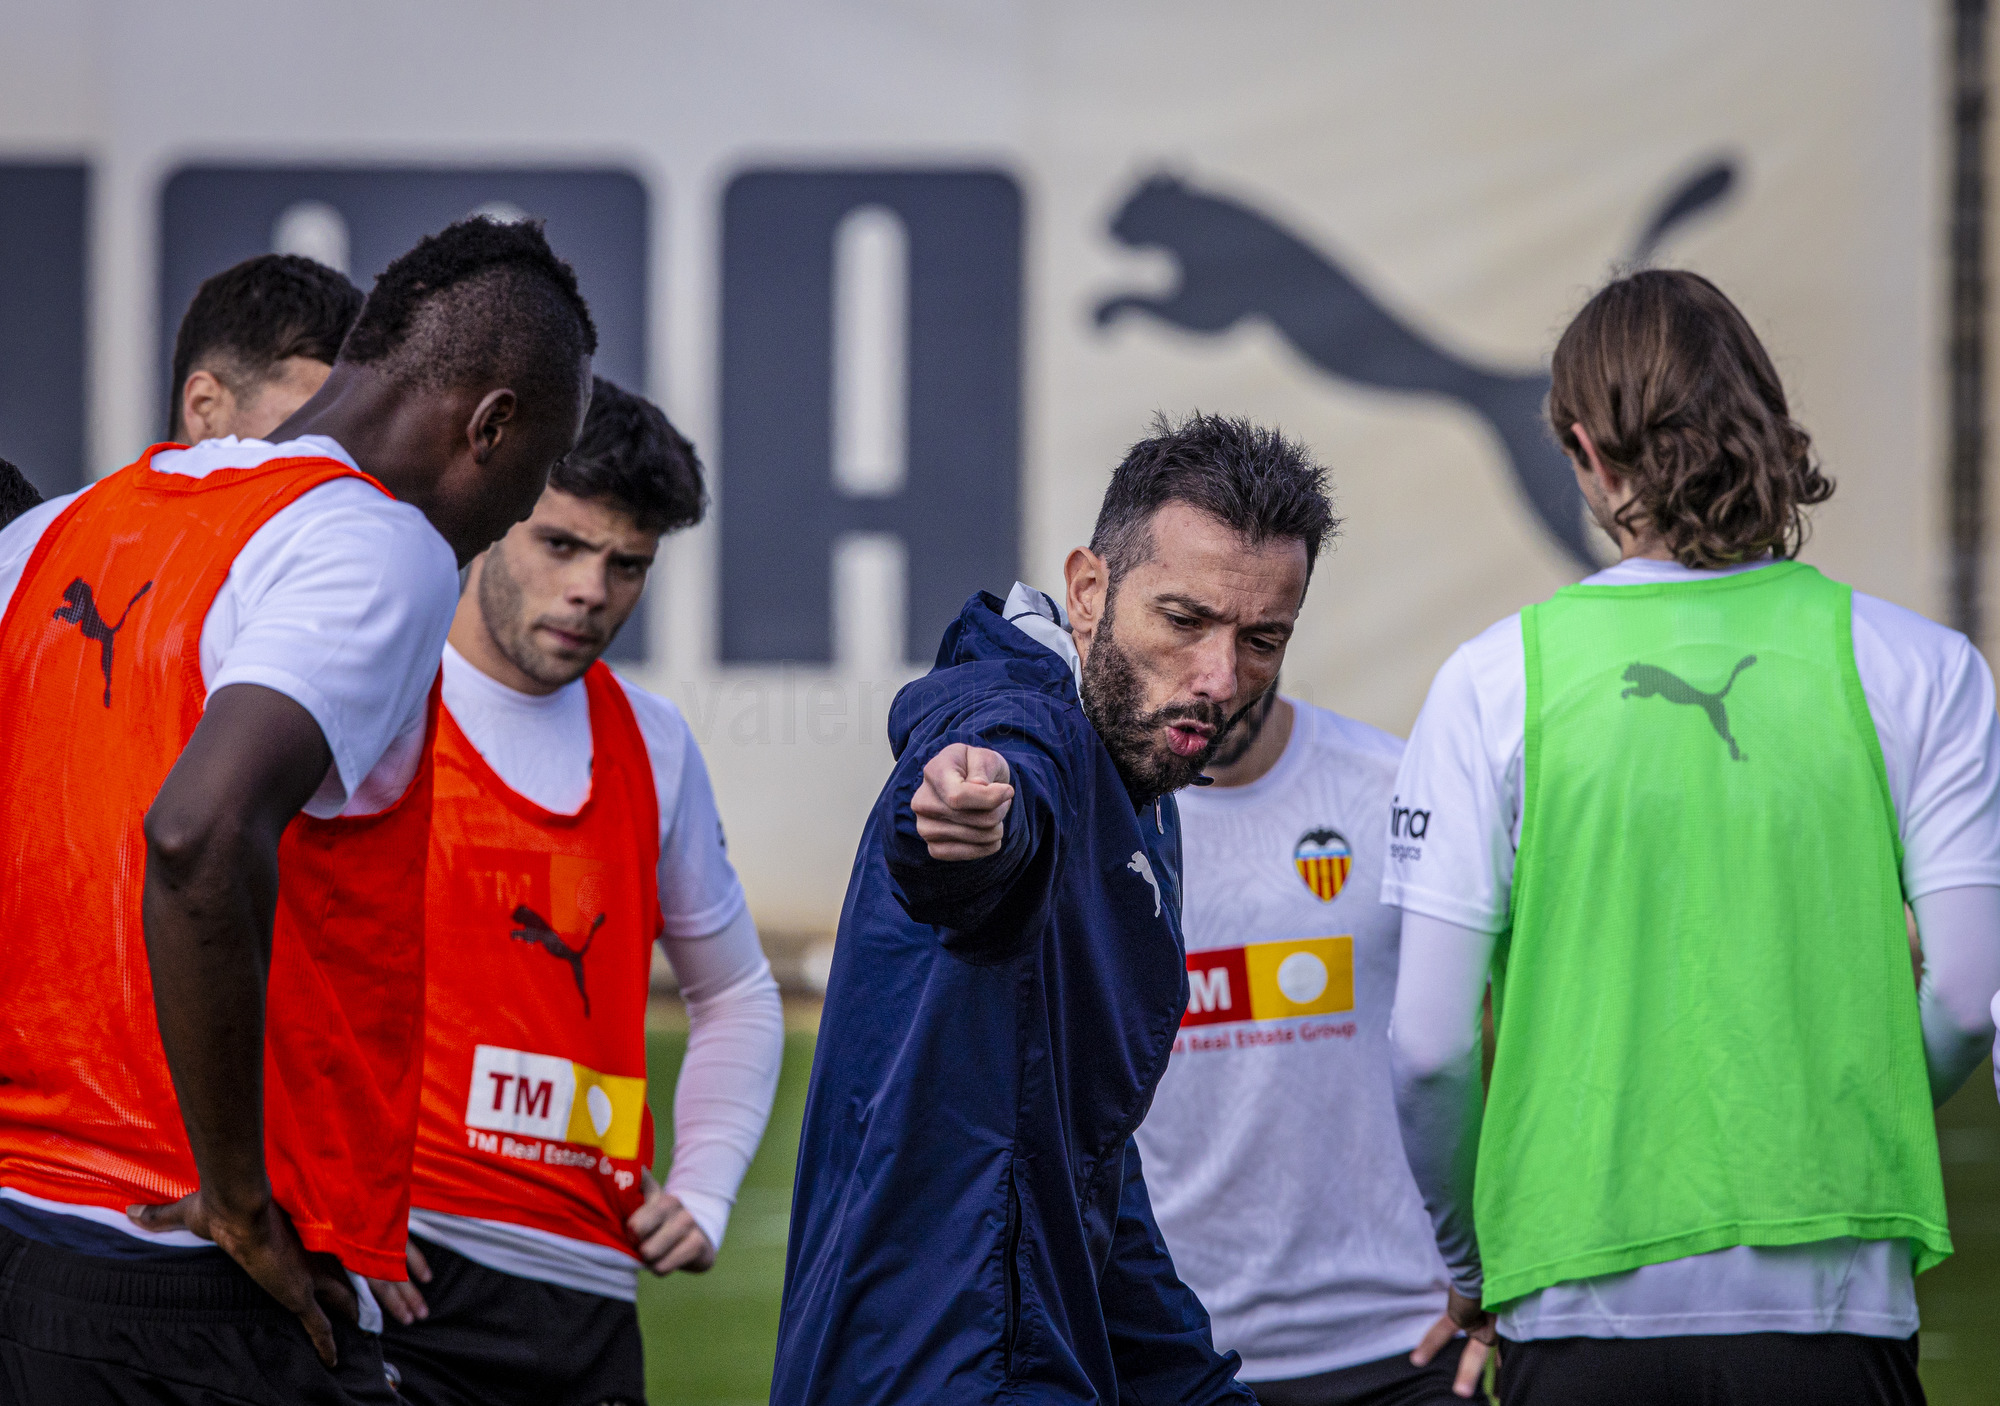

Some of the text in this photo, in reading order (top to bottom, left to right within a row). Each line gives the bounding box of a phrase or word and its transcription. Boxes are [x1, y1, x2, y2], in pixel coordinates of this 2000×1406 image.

[1189, 1034, 1231, 1053] Real
[1235, 1027, 1297, 1049] Estate
[1300, 1021, 1357, 1043] Group
[488, 1070, 554, 1119] TM
[466, 1128, 498, 1154] TM
[501, 1137, 542, 1161] Real
[543, 1143, 597, 1169] Estate
